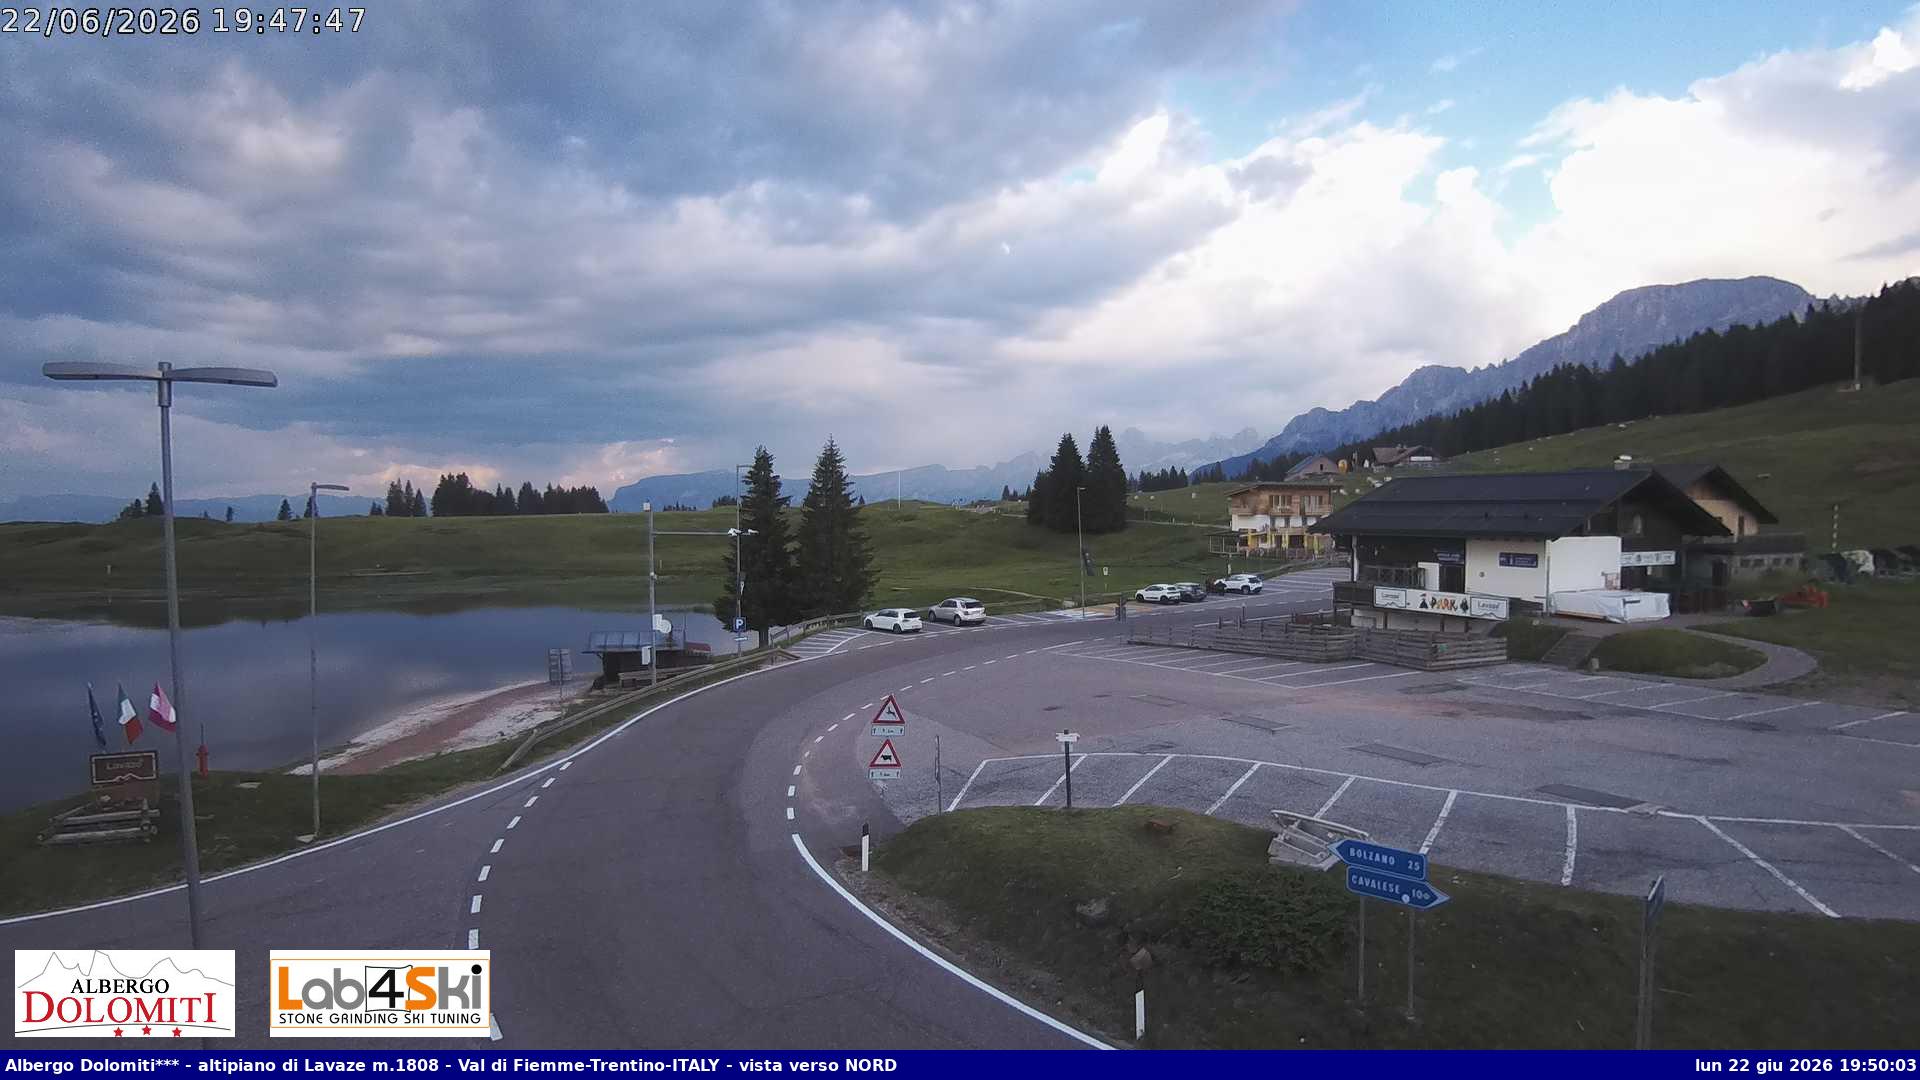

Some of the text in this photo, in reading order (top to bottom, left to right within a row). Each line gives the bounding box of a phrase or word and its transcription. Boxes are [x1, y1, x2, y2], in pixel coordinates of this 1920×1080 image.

[1349, 847, 1421, 872] BOLZANO 25
[1351, 874, 1401, 895] CAVALESE
